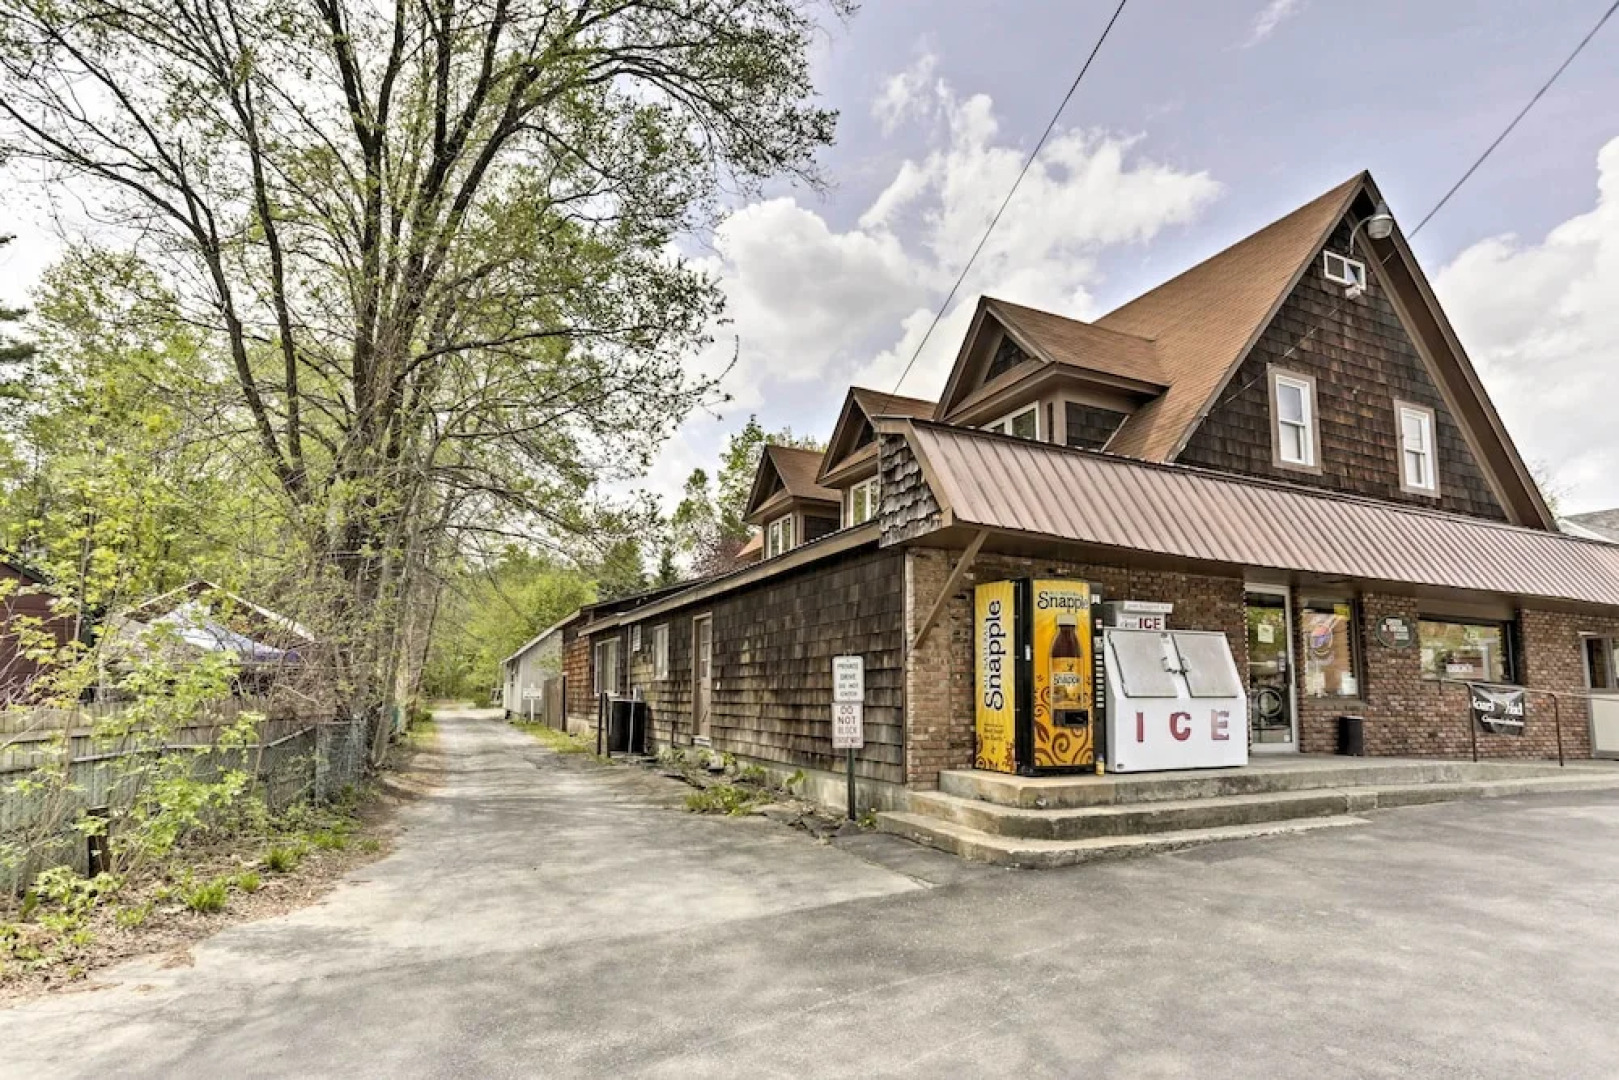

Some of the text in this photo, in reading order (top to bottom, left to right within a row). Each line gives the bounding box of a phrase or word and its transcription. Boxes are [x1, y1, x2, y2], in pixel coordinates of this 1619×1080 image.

[1037, 591, 1089, 613] Snapple
[1139, 617, 1161, 629] ICE
[984, 600, 1006, 711] Snapple
[840, 705, 853, 714] DO
[838, 716, 856, 724] NOT
[1136, 709, 1230, 743] ICE
